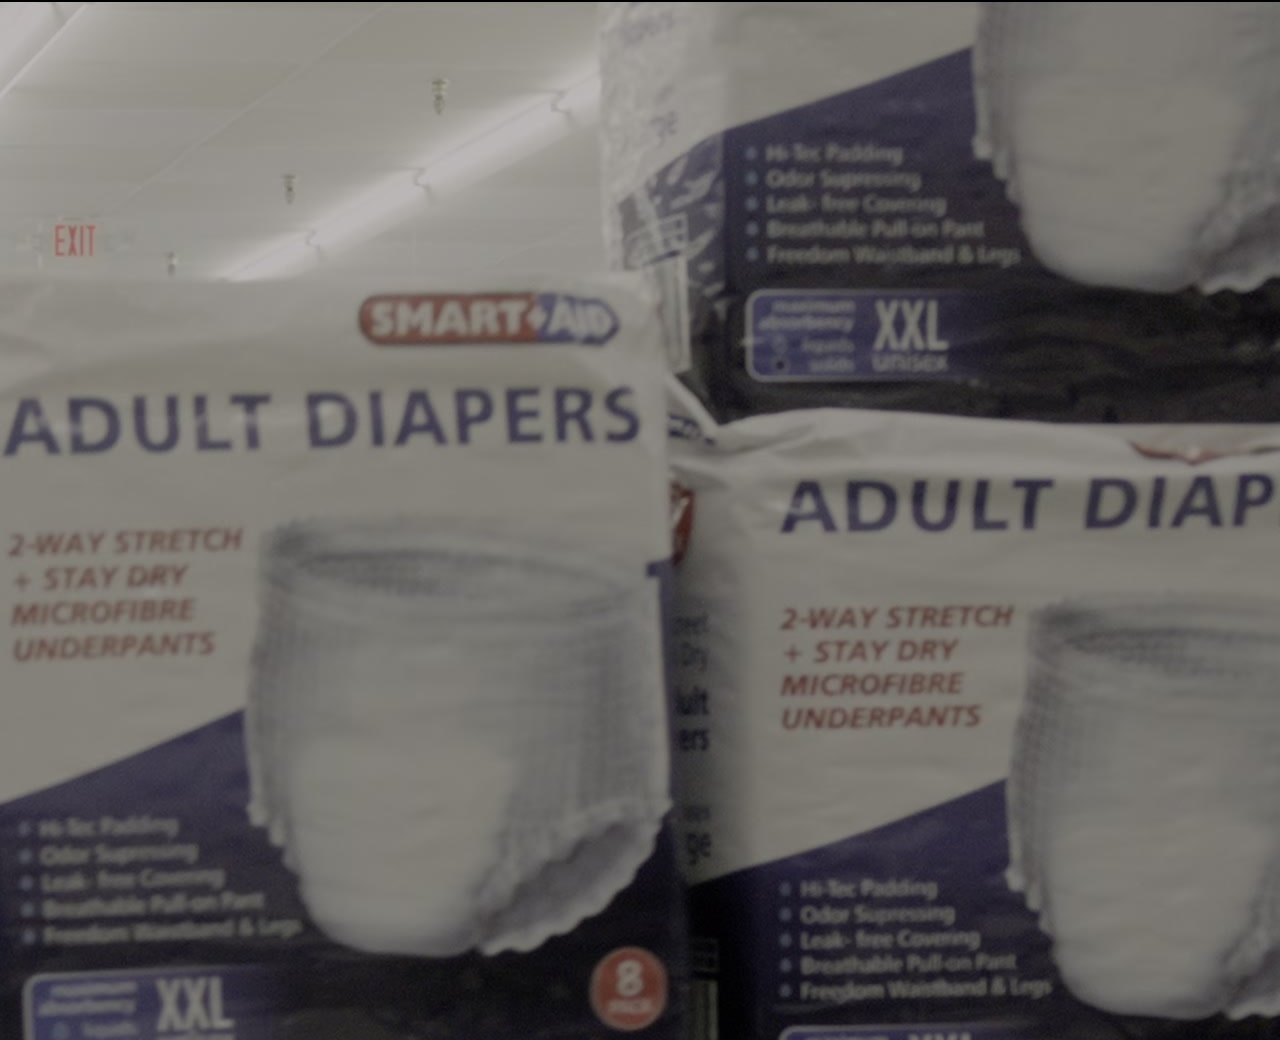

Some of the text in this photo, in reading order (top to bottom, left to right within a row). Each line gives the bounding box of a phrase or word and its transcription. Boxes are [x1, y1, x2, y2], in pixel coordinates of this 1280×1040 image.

[54, 224, 97, 257] EXIT
[370, 301, 609, 340] SMART+AID
[873, 299, 949, 351] XXL
[872, 353, 949, 373] unisex
[4, 386, 642, 457] ADULT DIAPERS
[781, 478, 1053, 534] ADULT
[8, 528, 244, 556] 2-WAY STRETCH
[38, 566, 119, 591] STAY
[126, 564, 189, 589] DRY
[11, 599, 195, 627] MICROFIBRE
[781, 606, 1014, 631] 2-WAY STRETCH
[13, 632, 215, 662] UNDERPANTS
[814, 640, 890, 664] STAY
[898, 640, 958, 662] DRY
[781, 673, 966, 697] MICROFIBRE
[782, 705, 983, 731] UNDERPANTS
[860, 879, 938, 901] Padding
[800, 905, 850, 925] Odor
[896, 929, 981, 952] Covering
[616, 960, 642, 997] 8
[157, 976, 236, 1032] XXL
